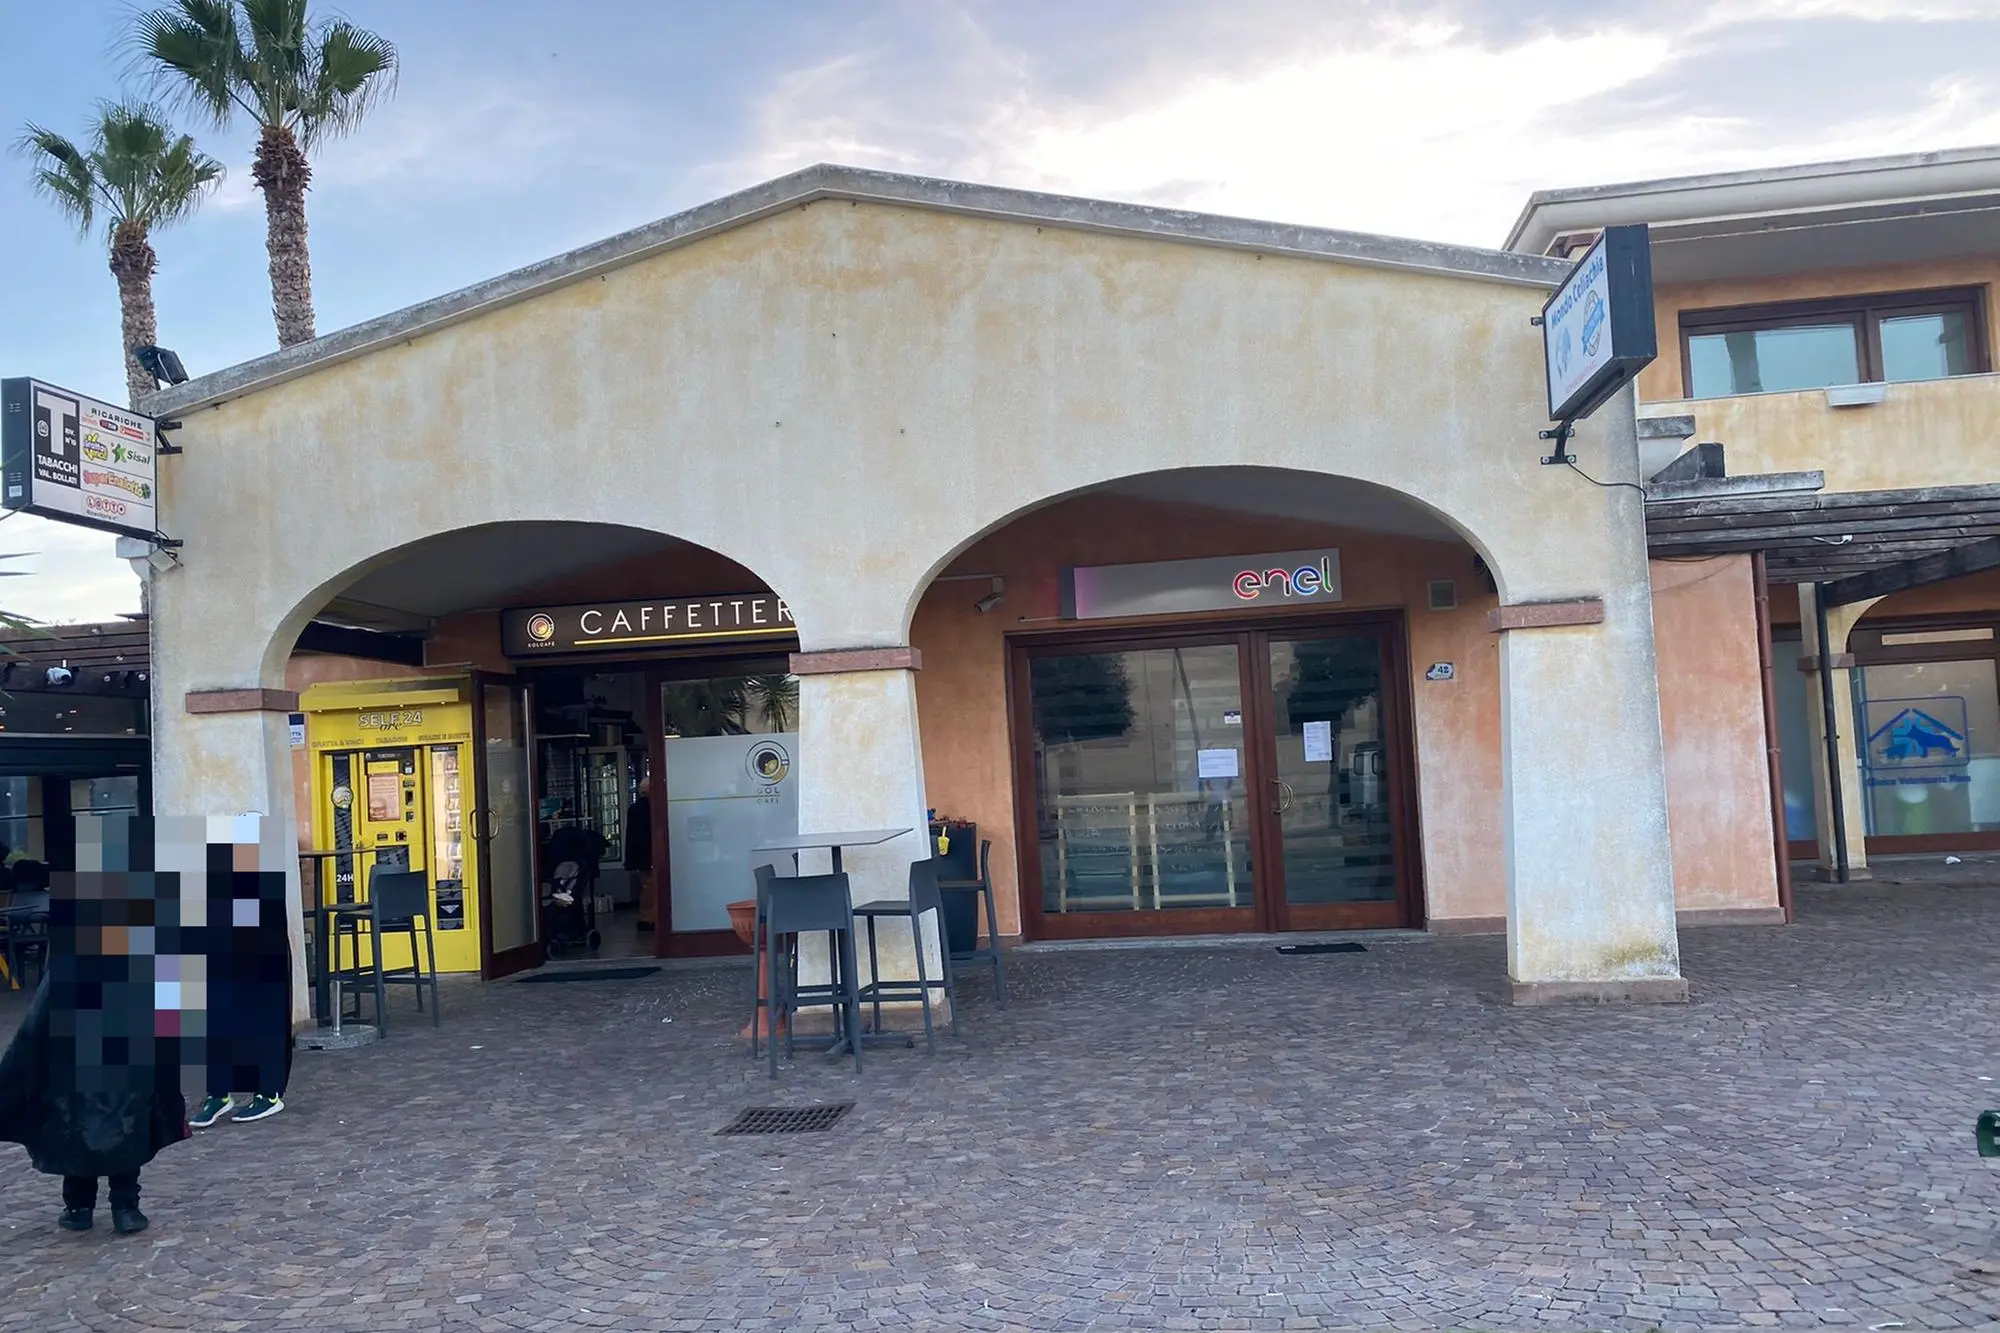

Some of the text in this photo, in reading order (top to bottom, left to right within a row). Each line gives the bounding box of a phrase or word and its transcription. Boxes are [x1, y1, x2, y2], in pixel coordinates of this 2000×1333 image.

[1550, 294, 1573, 330] Mondo
[1572, 255, 1605, 304] Celiachia
[37, 390, 76, 456] T
[91, 407, 143, 430] RICARICHE
[37, 454, 78, 474] TABACCHI
[126, 450, 151, 465] Sisal
[86, 495, 126, 516] LOTTO
[1232, 555, 1334, 601] enel
[358, 710, 423, 727] SELF 24
[336, 874, 354, 883] 24H
